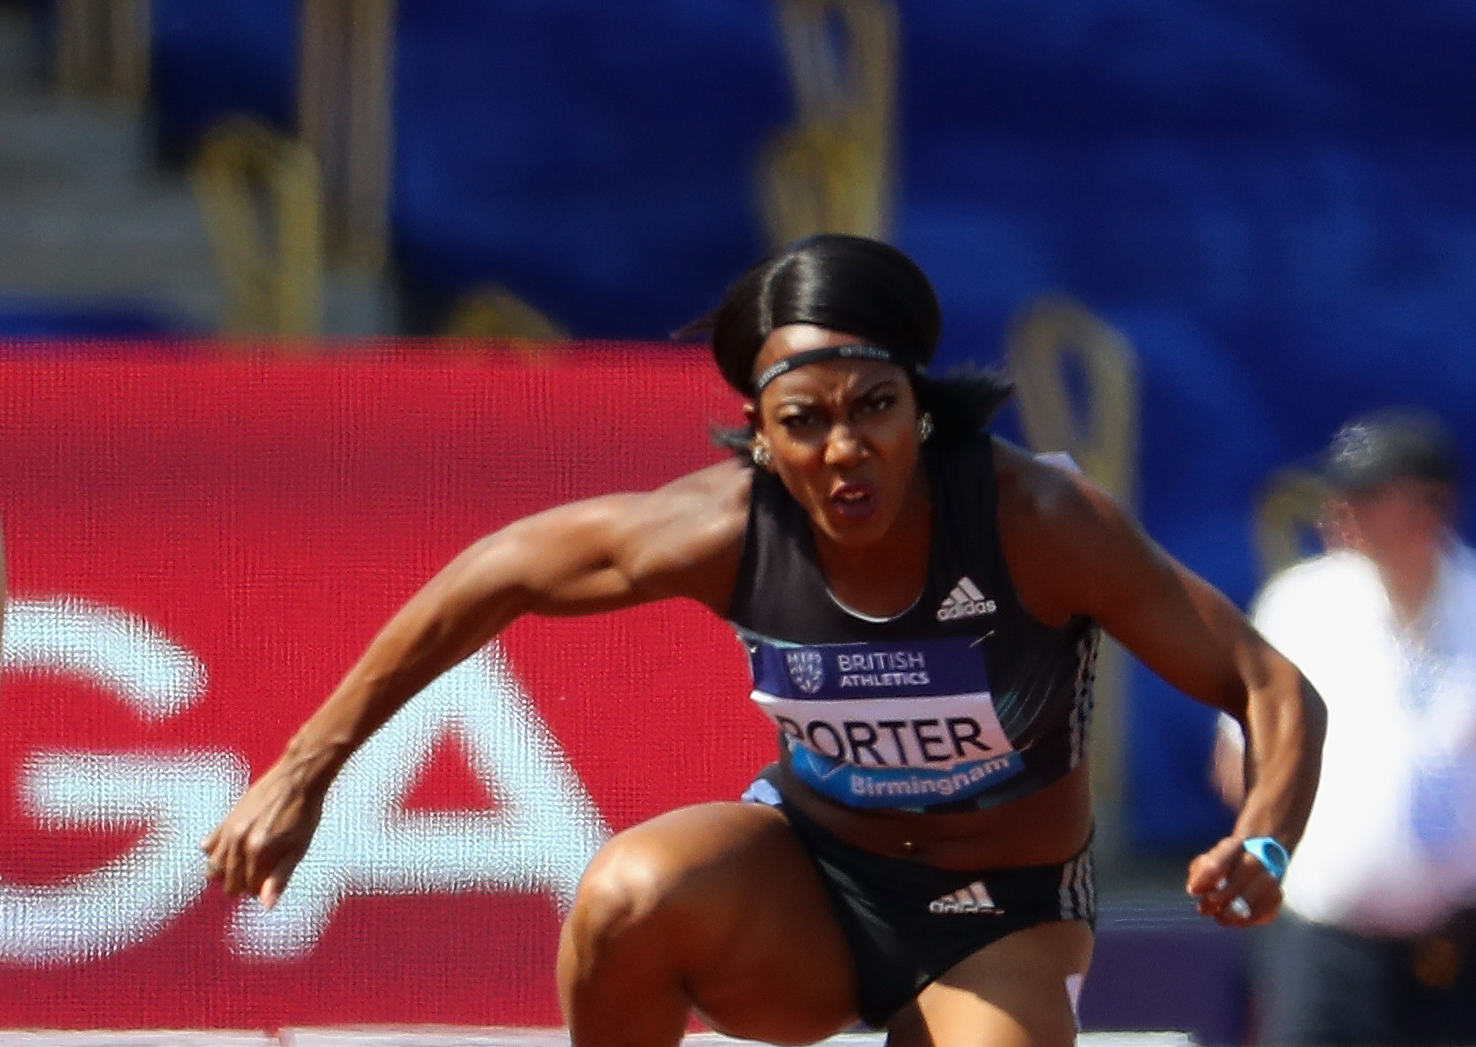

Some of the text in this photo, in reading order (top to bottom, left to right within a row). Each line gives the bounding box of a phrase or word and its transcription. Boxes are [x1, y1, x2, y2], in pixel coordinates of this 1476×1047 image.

[936, 600, 997, 621] adidas
[838, 651, 925, 672] BRITISH
[840, 672, 931, 688] ATHLETICS
[850, 756, 1011, 796] Birmingham
